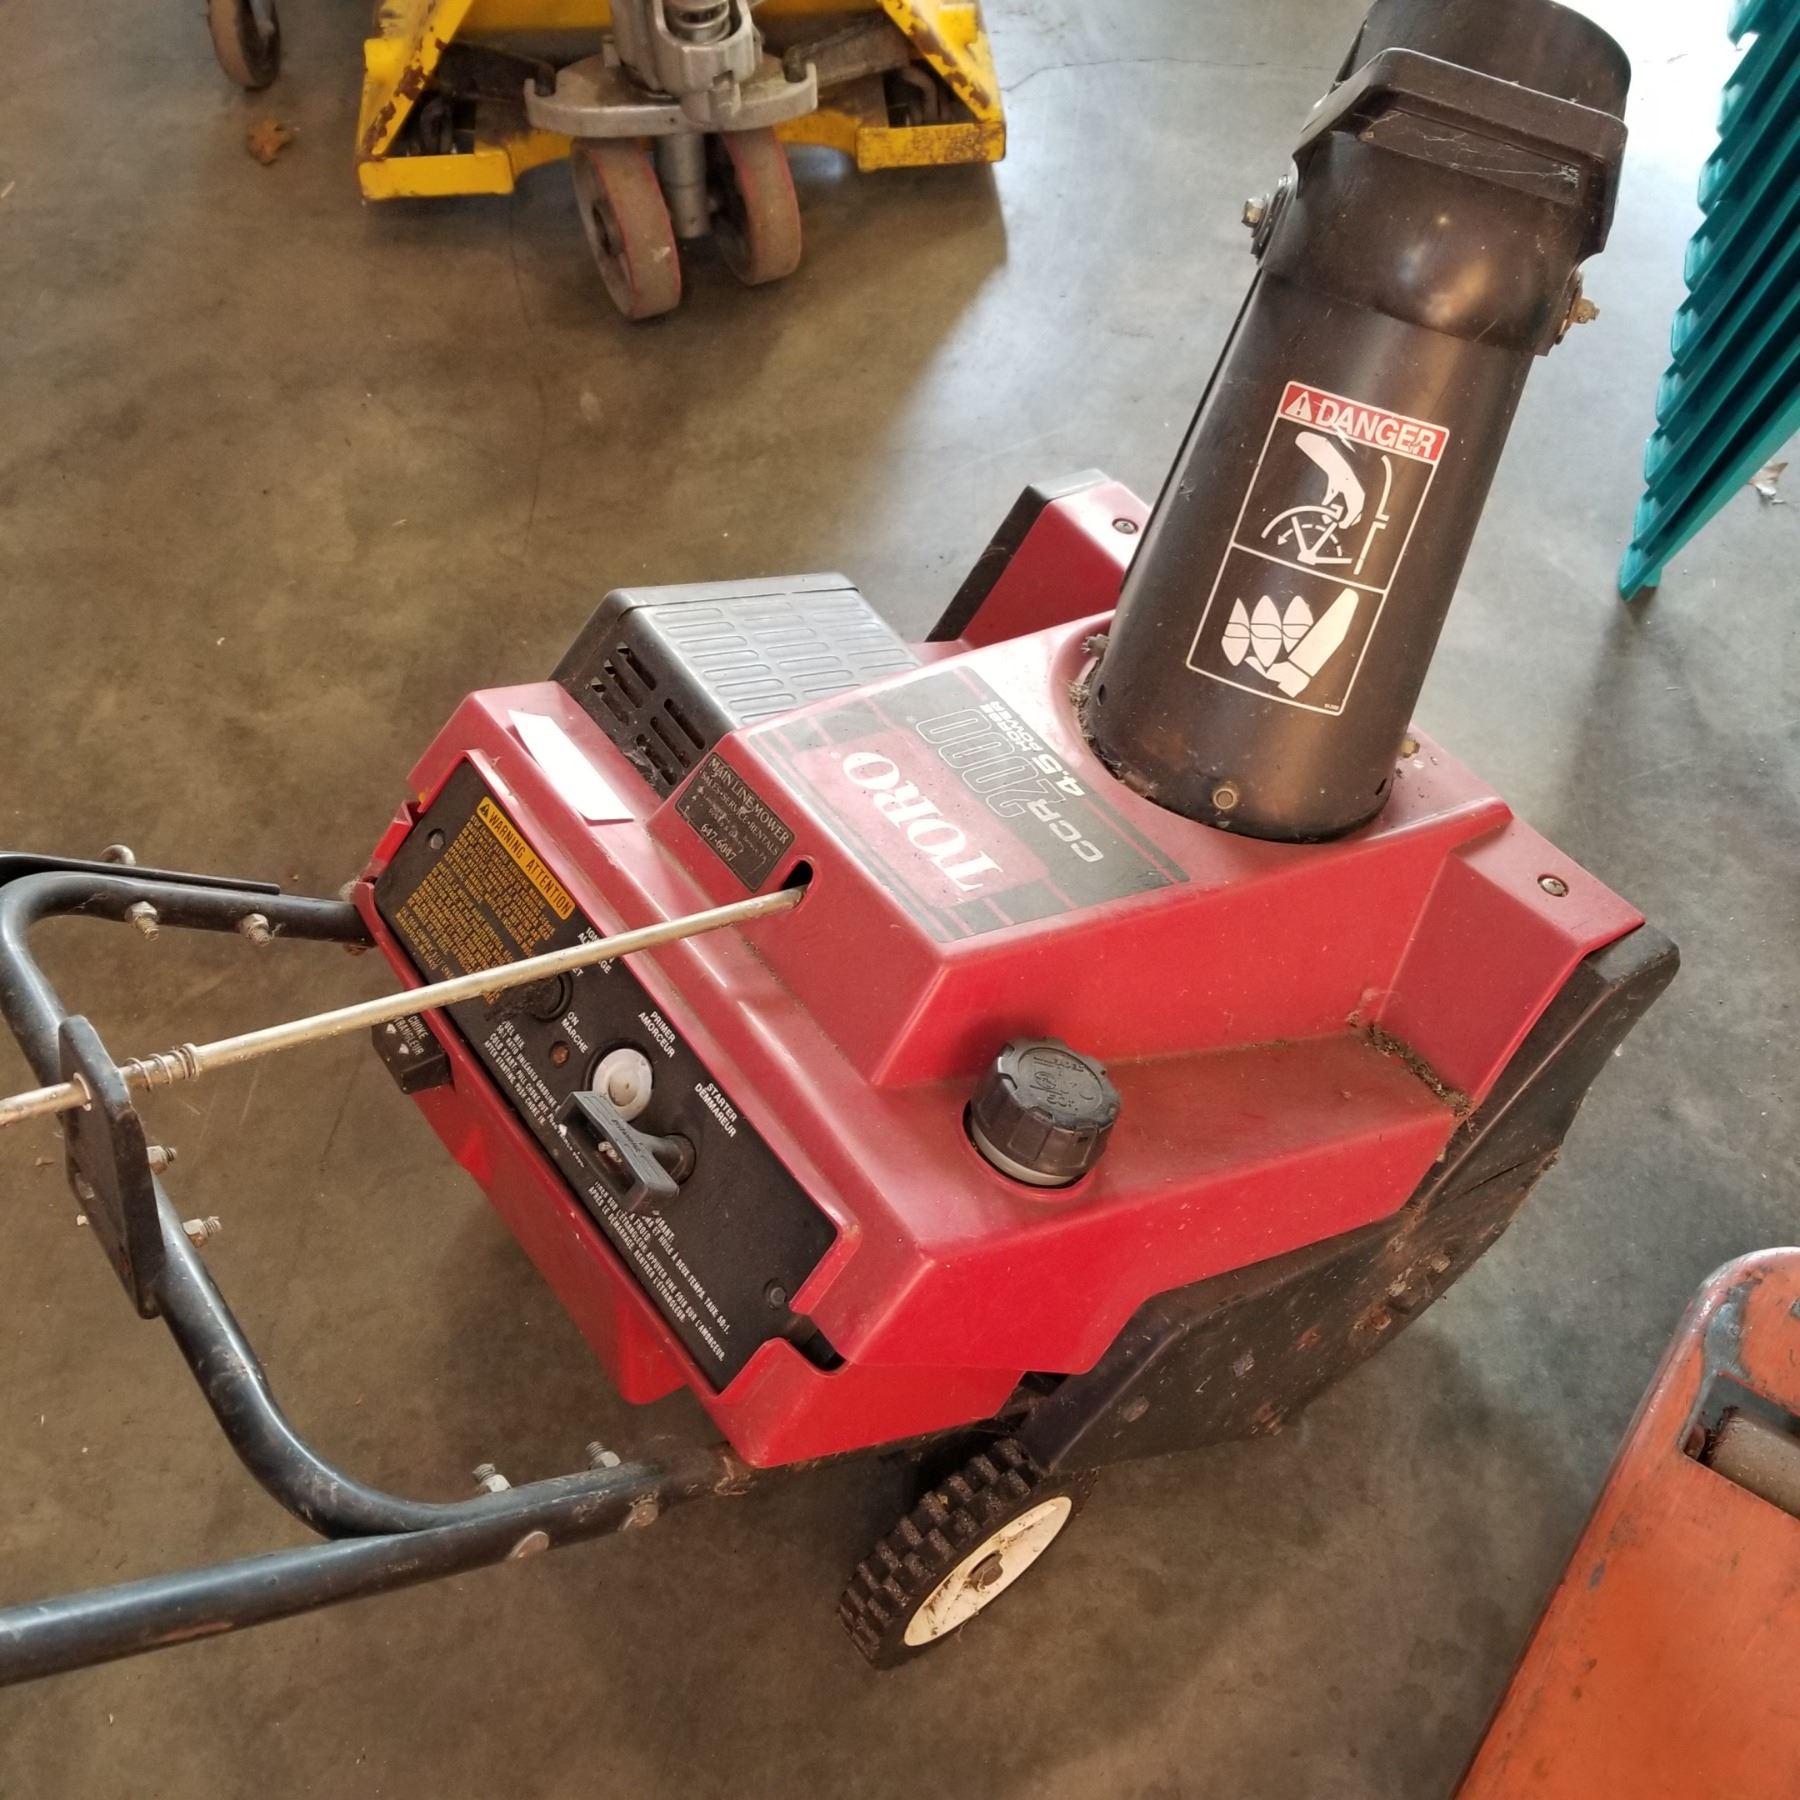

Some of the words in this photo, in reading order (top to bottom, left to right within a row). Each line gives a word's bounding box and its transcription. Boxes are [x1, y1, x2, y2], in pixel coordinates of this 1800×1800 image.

[1315, 398, 1436, 458] DANGER
[980, 703, 1033, 752] HORSE
[989, 701, 1044, 752] POWER
[915, 709, 1066, 818] 2000
[1032, 753, 1085, 796] 4.5
[709, 758, 733, 785] MAIN
[731, 782, 755, 808] LINE
[751, 804, 789, 843] MOWER
[843, 752, 1003, 891] TORO
[1026, 799, 1104, 863] CCR
[489, 813, 525, 858] WARNING
[526, 859, 571, 914] ATTENTION
[393, 1016, 424, 1055] TRANGLEUR
[407, 1015, 429, 1039] CHOKE
[561, 1019, 588, 1054] MARCHE
[567, 1011, 580, 1026] ON
[638, 1012, 676, 1058] AMORCEUR
[650, 1011, 676, 1043] PRIMER
[516, 1070, 527, 1085] PULL
[706, 1083, 738, 1122] STARTER
[602, 1205, 610, 1215] LE
[634, 1250, 655, 1278] RENTRER
[658, 1235, 673, 1255] HUILE
[676, 1259, 690, 1277] DEUX
[646, 1252, 667, 1279] APPUYER
[665, 1278, 677, 1293] UNE
[675, 1292, 687, 1308] FOIS
[685, 1306, 697, 1321] SUR
